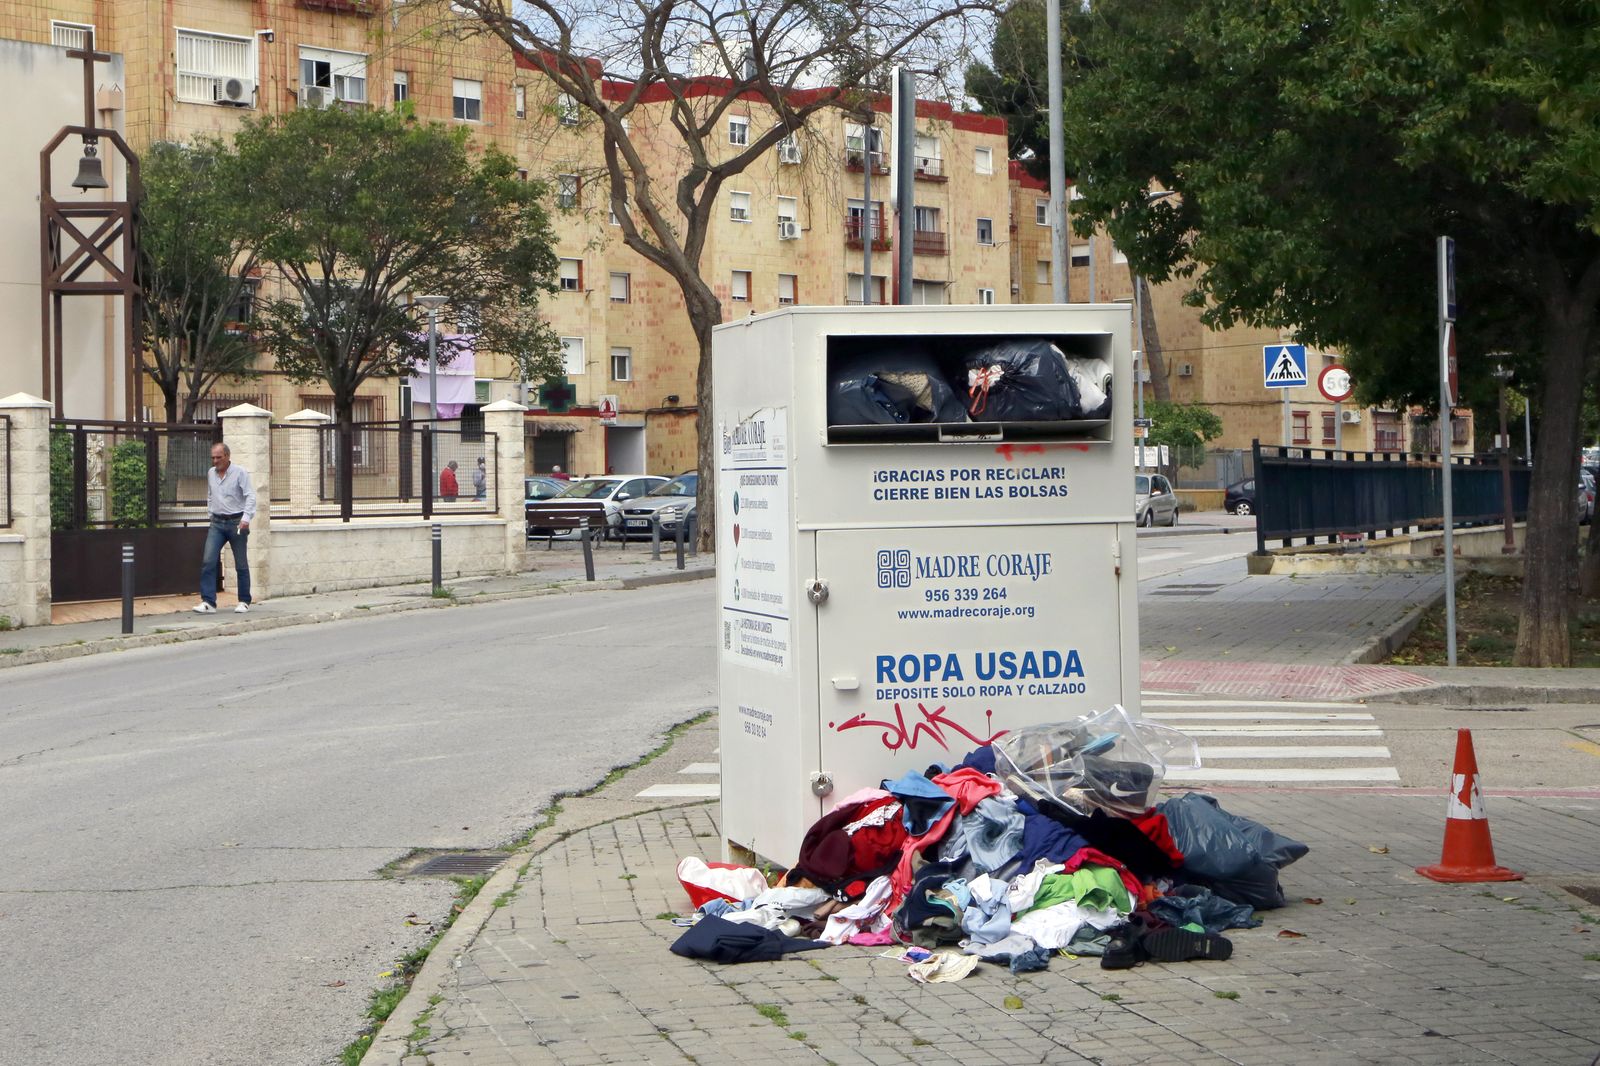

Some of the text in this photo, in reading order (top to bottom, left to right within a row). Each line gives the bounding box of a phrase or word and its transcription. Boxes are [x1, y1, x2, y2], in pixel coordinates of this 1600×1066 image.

[873, 466, 1066, 483] ¡GRACIAS POR RECICLAR!
[873, 485, 1068, 501] CIERRE BIEN LAS BOLSAS
[916, 553, 1052, 581] MADRE CORAJE
[925, 587, 1007, 602] 956 339 264
[898, 605, 1035, 619] www.madrecoraje.org
[877, 650, 1085, 684] ROPA USADA
[876, 683, 1086, 700] DEPOSITE SOLO ROPA Y CALZADO
